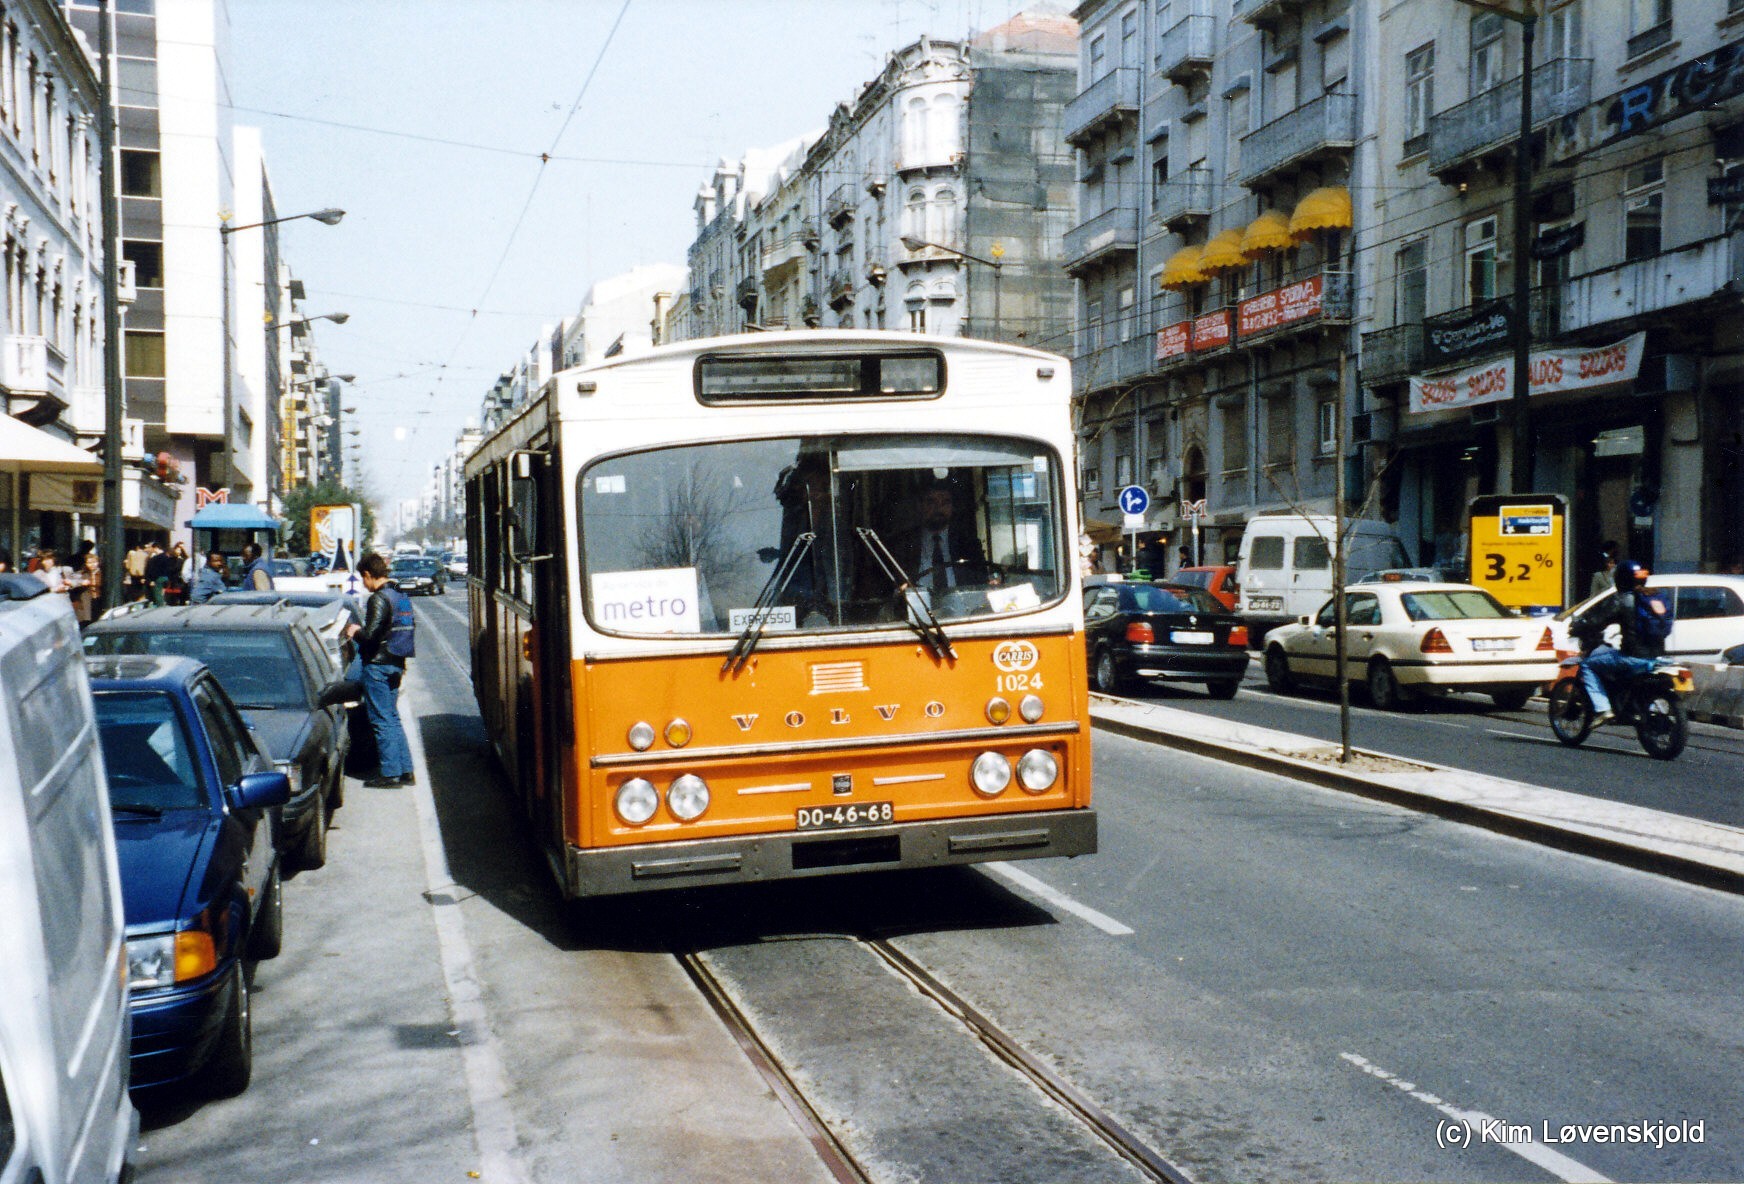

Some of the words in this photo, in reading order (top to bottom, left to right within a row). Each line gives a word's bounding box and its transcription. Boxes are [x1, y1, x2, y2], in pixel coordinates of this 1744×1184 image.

[1421, 380, 1457, 405] SALDOS
[1468, 367, 1507, 398] SALDOS
[1528, 357, 1564, 387] ALDOS
[1579, 344, 1627, 380] SALDOS
[1182, 499, 1207, 520] M
[603, 595, 687, 621] metro
[733, 612, 792, 627] EXPRESSO
[999, 650, 1034, 663] CARRIS
[996, 672, 1044, 693] 1024
[731, 701, 946, 731] VOLVO
[798, 803, 892, 827] DO-46-68
